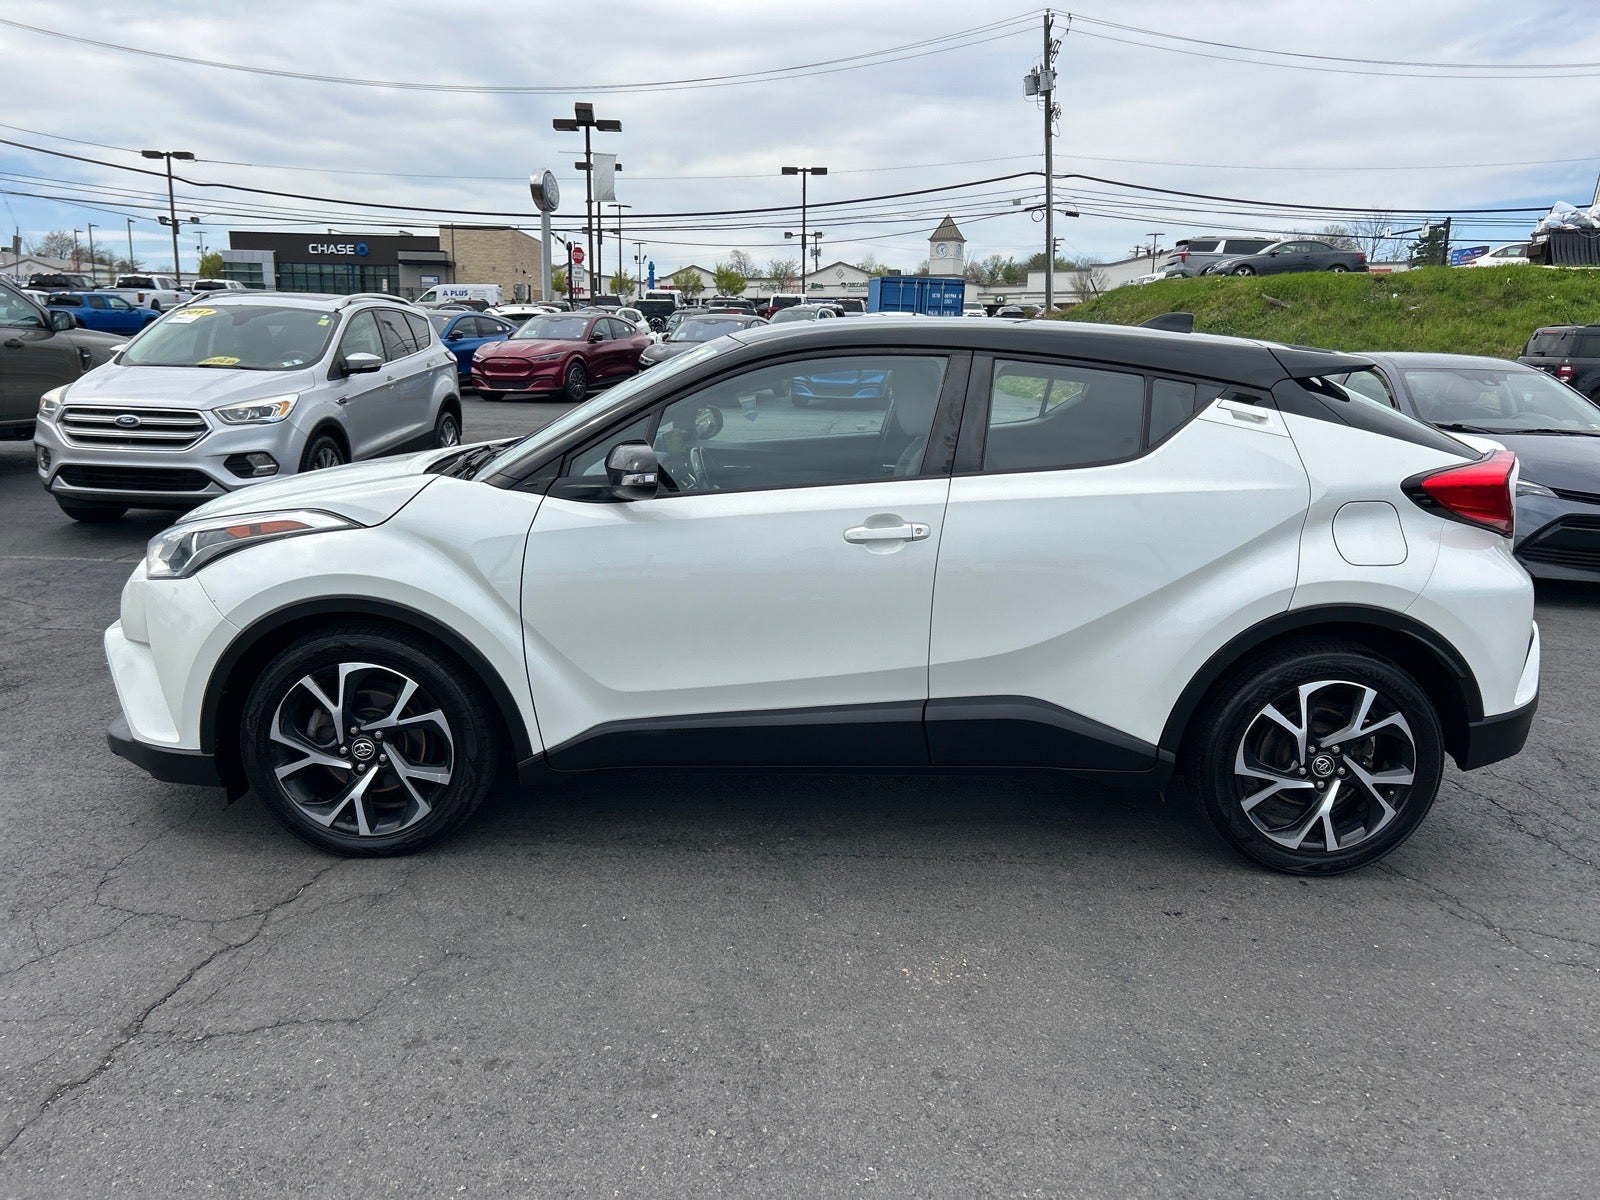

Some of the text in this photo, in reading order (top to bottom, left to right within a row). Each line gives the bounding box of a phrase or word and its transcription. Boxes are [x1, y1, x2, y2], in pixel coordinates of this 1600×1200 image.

[308, 243, 355, 255] CHASE
[573, 251, 584, 260] STOP
[450, 289, 469, 297] PLUS
